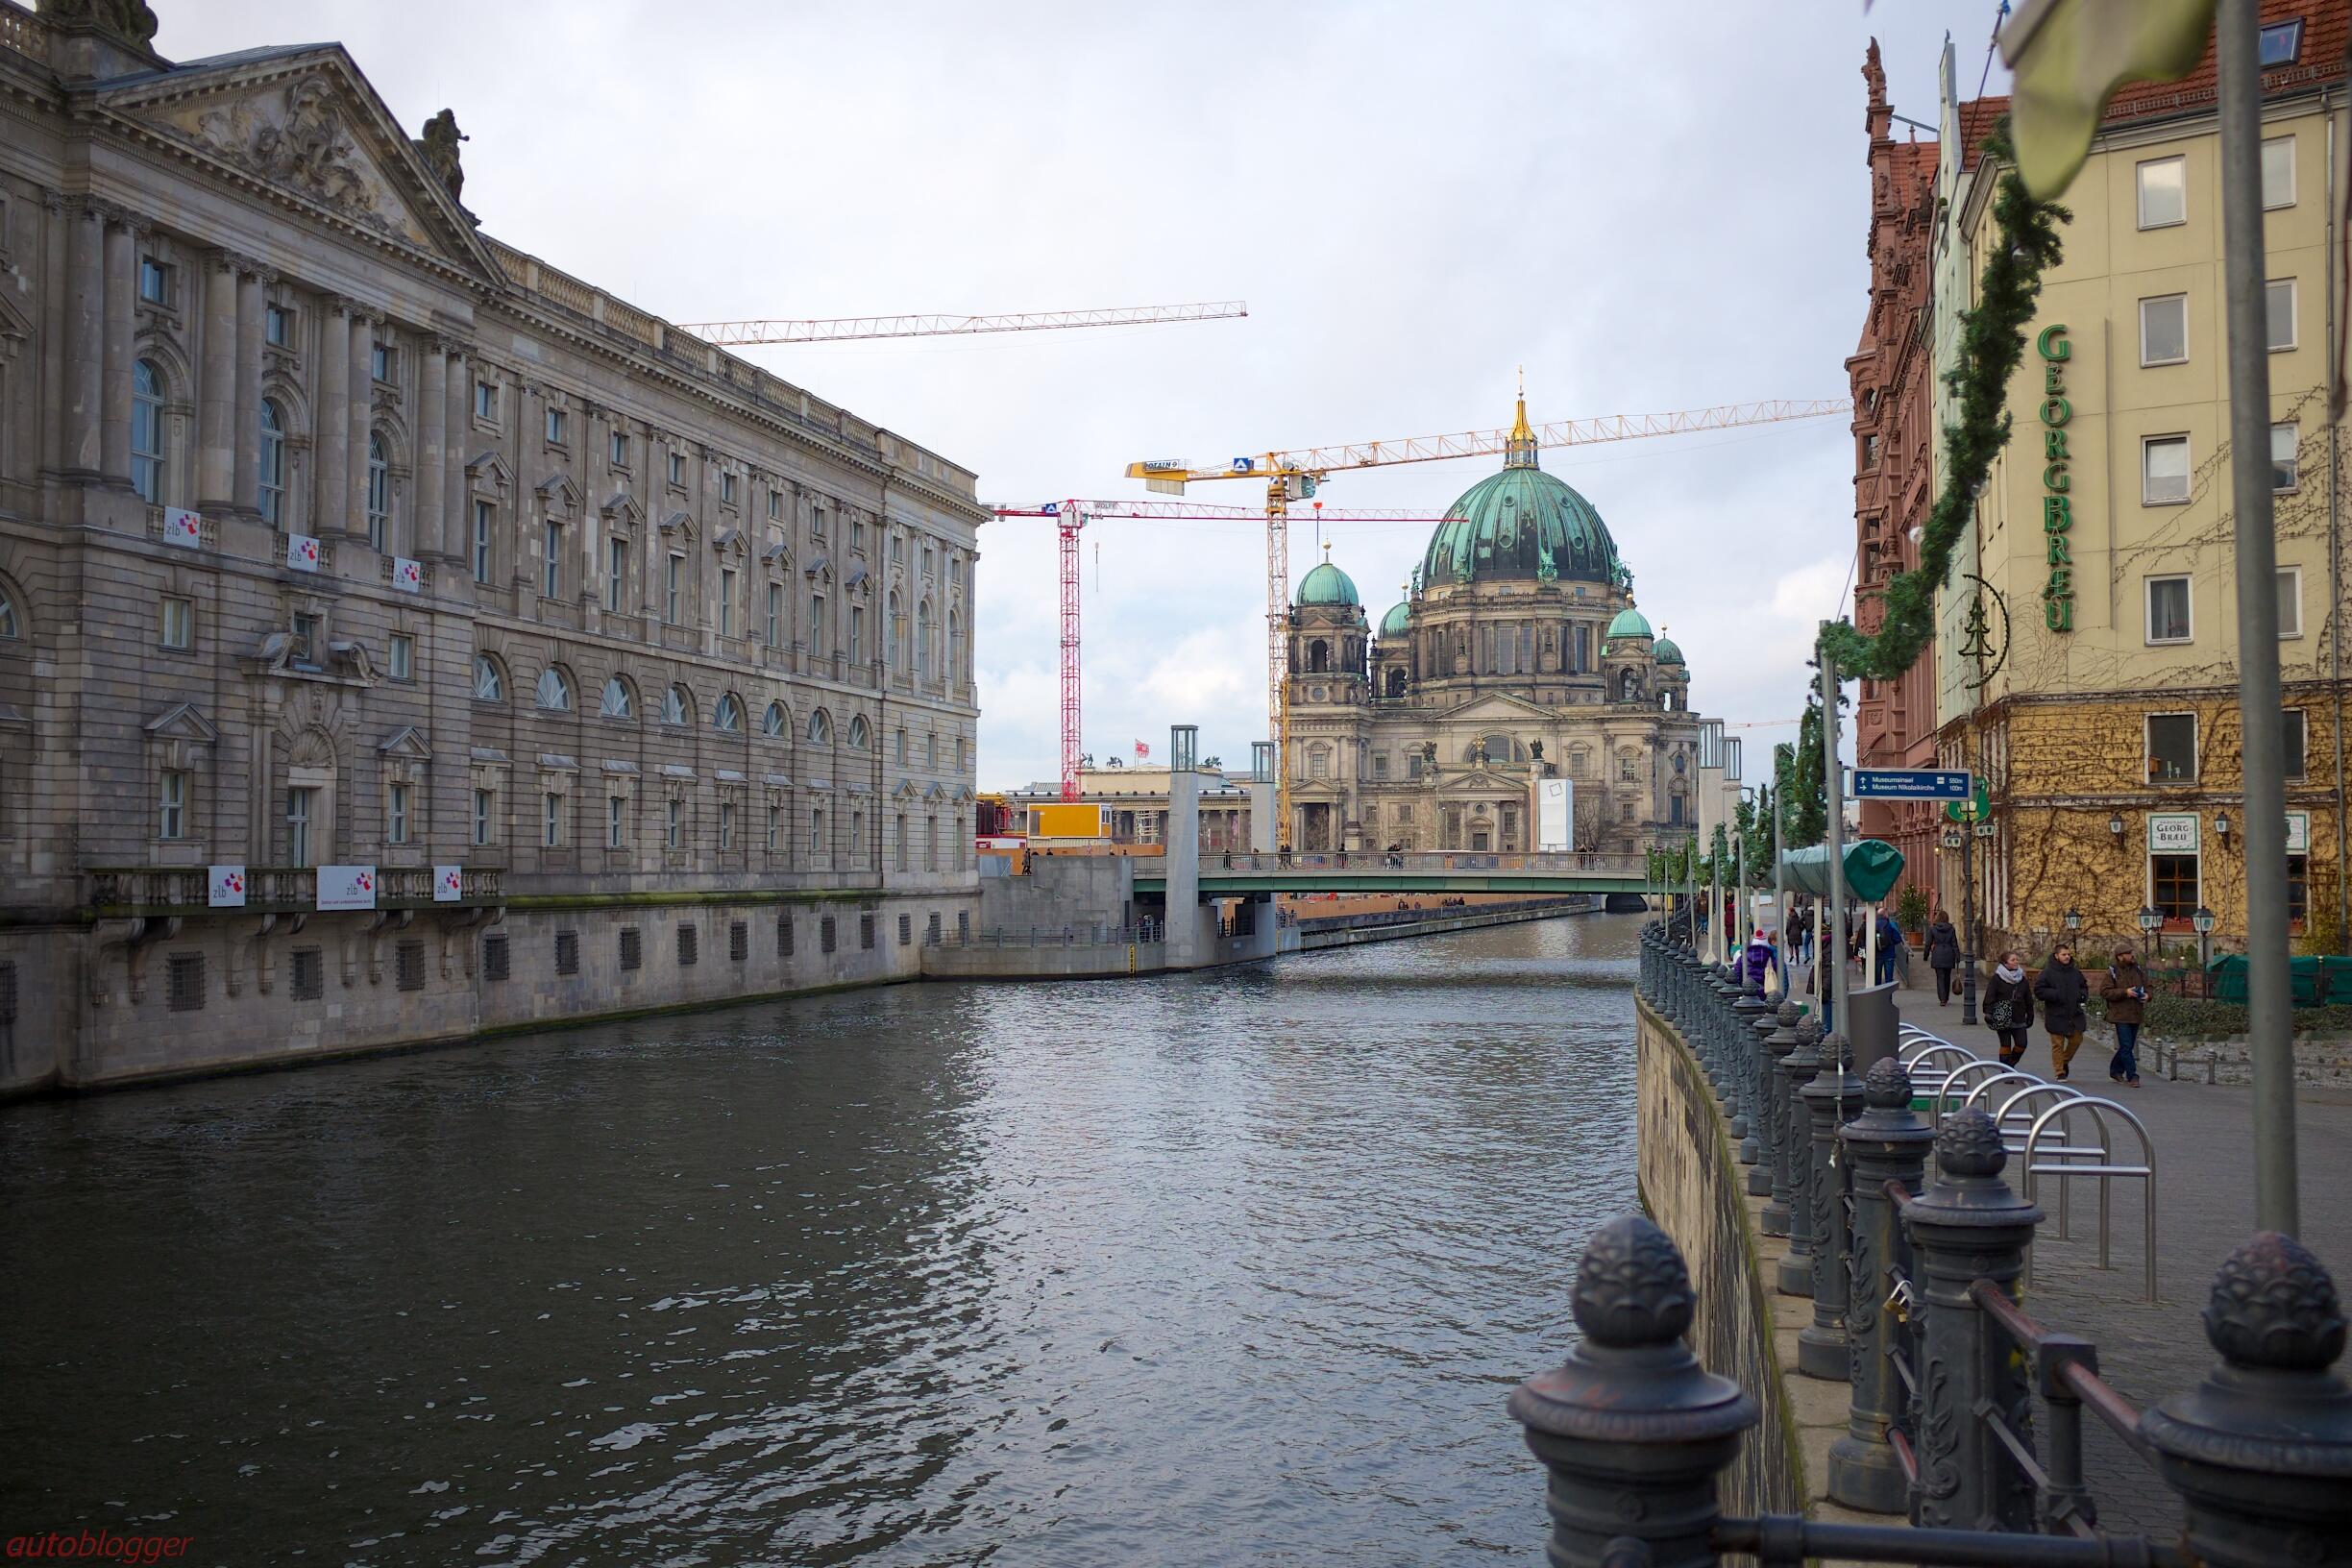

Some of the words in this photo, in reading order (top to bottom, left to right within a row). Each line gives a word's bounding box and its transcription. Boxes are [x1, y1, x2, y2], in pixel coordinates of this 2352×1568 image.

[166, 523, 181, 536] zlb
[289, 549, 302, 562] zlb
[395, 570, 405, 584] zlb
[2156, 823, 2189, 832] GEORG
[213, 884, 227, 898] zlb
[346, 883, 358, 895] zlb
[437, 882, 448, 894] zlb
